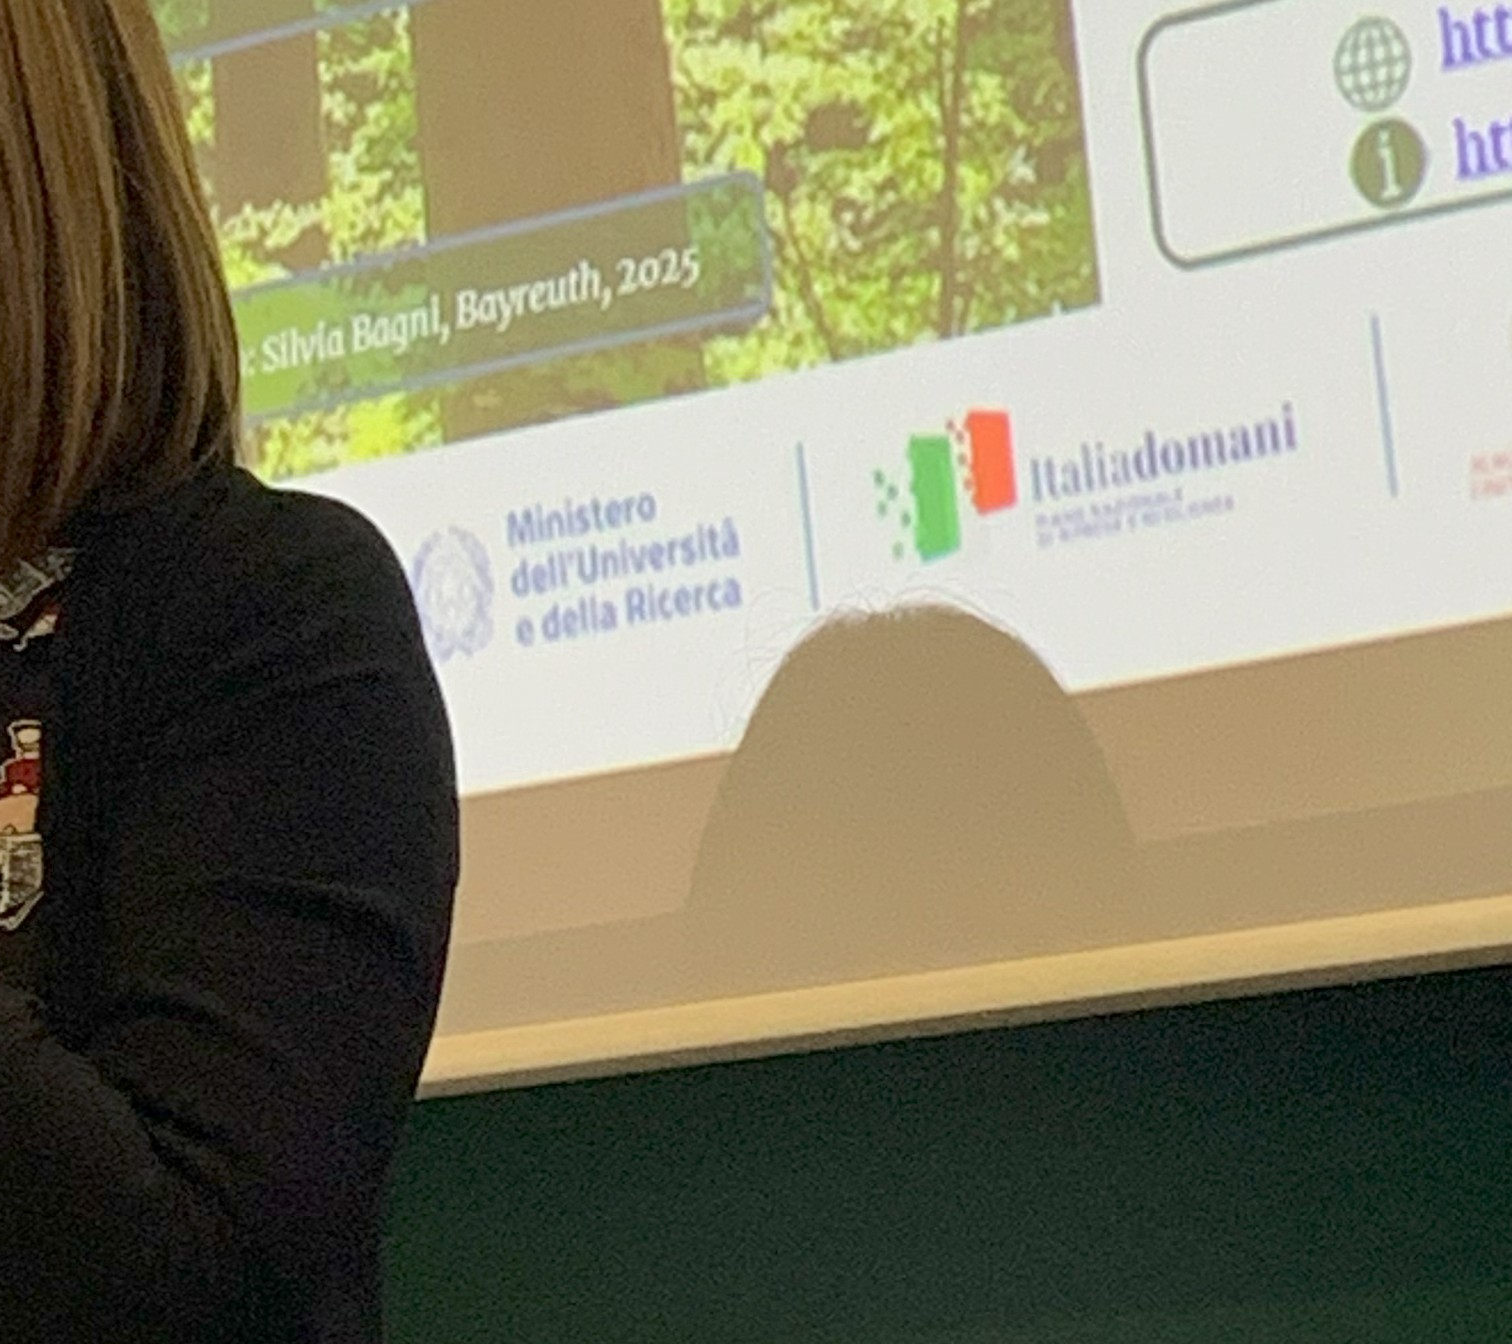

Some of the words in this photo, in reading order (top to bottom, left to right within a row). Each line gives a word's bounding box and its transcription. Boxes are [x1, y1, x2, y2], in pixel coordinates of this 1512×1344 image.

[1453, 119, 1512, 178] ht
[262, 320, 345, 374] Silvia
[352, 292, 450, 355] Bagni,
[456, 258, 612, 332] Bayreuth,
[616, 248, 701, 296] 2025
[1031, 400, 1297, 502] Italiadomani
[507, 492, 656, 547] Ministero
[511, 516, 740, 597] dell'Università
[516, 616, 534, 646] e
[542, 594, 617, 642] della
[625, 577, 742, 625] Ricerca
